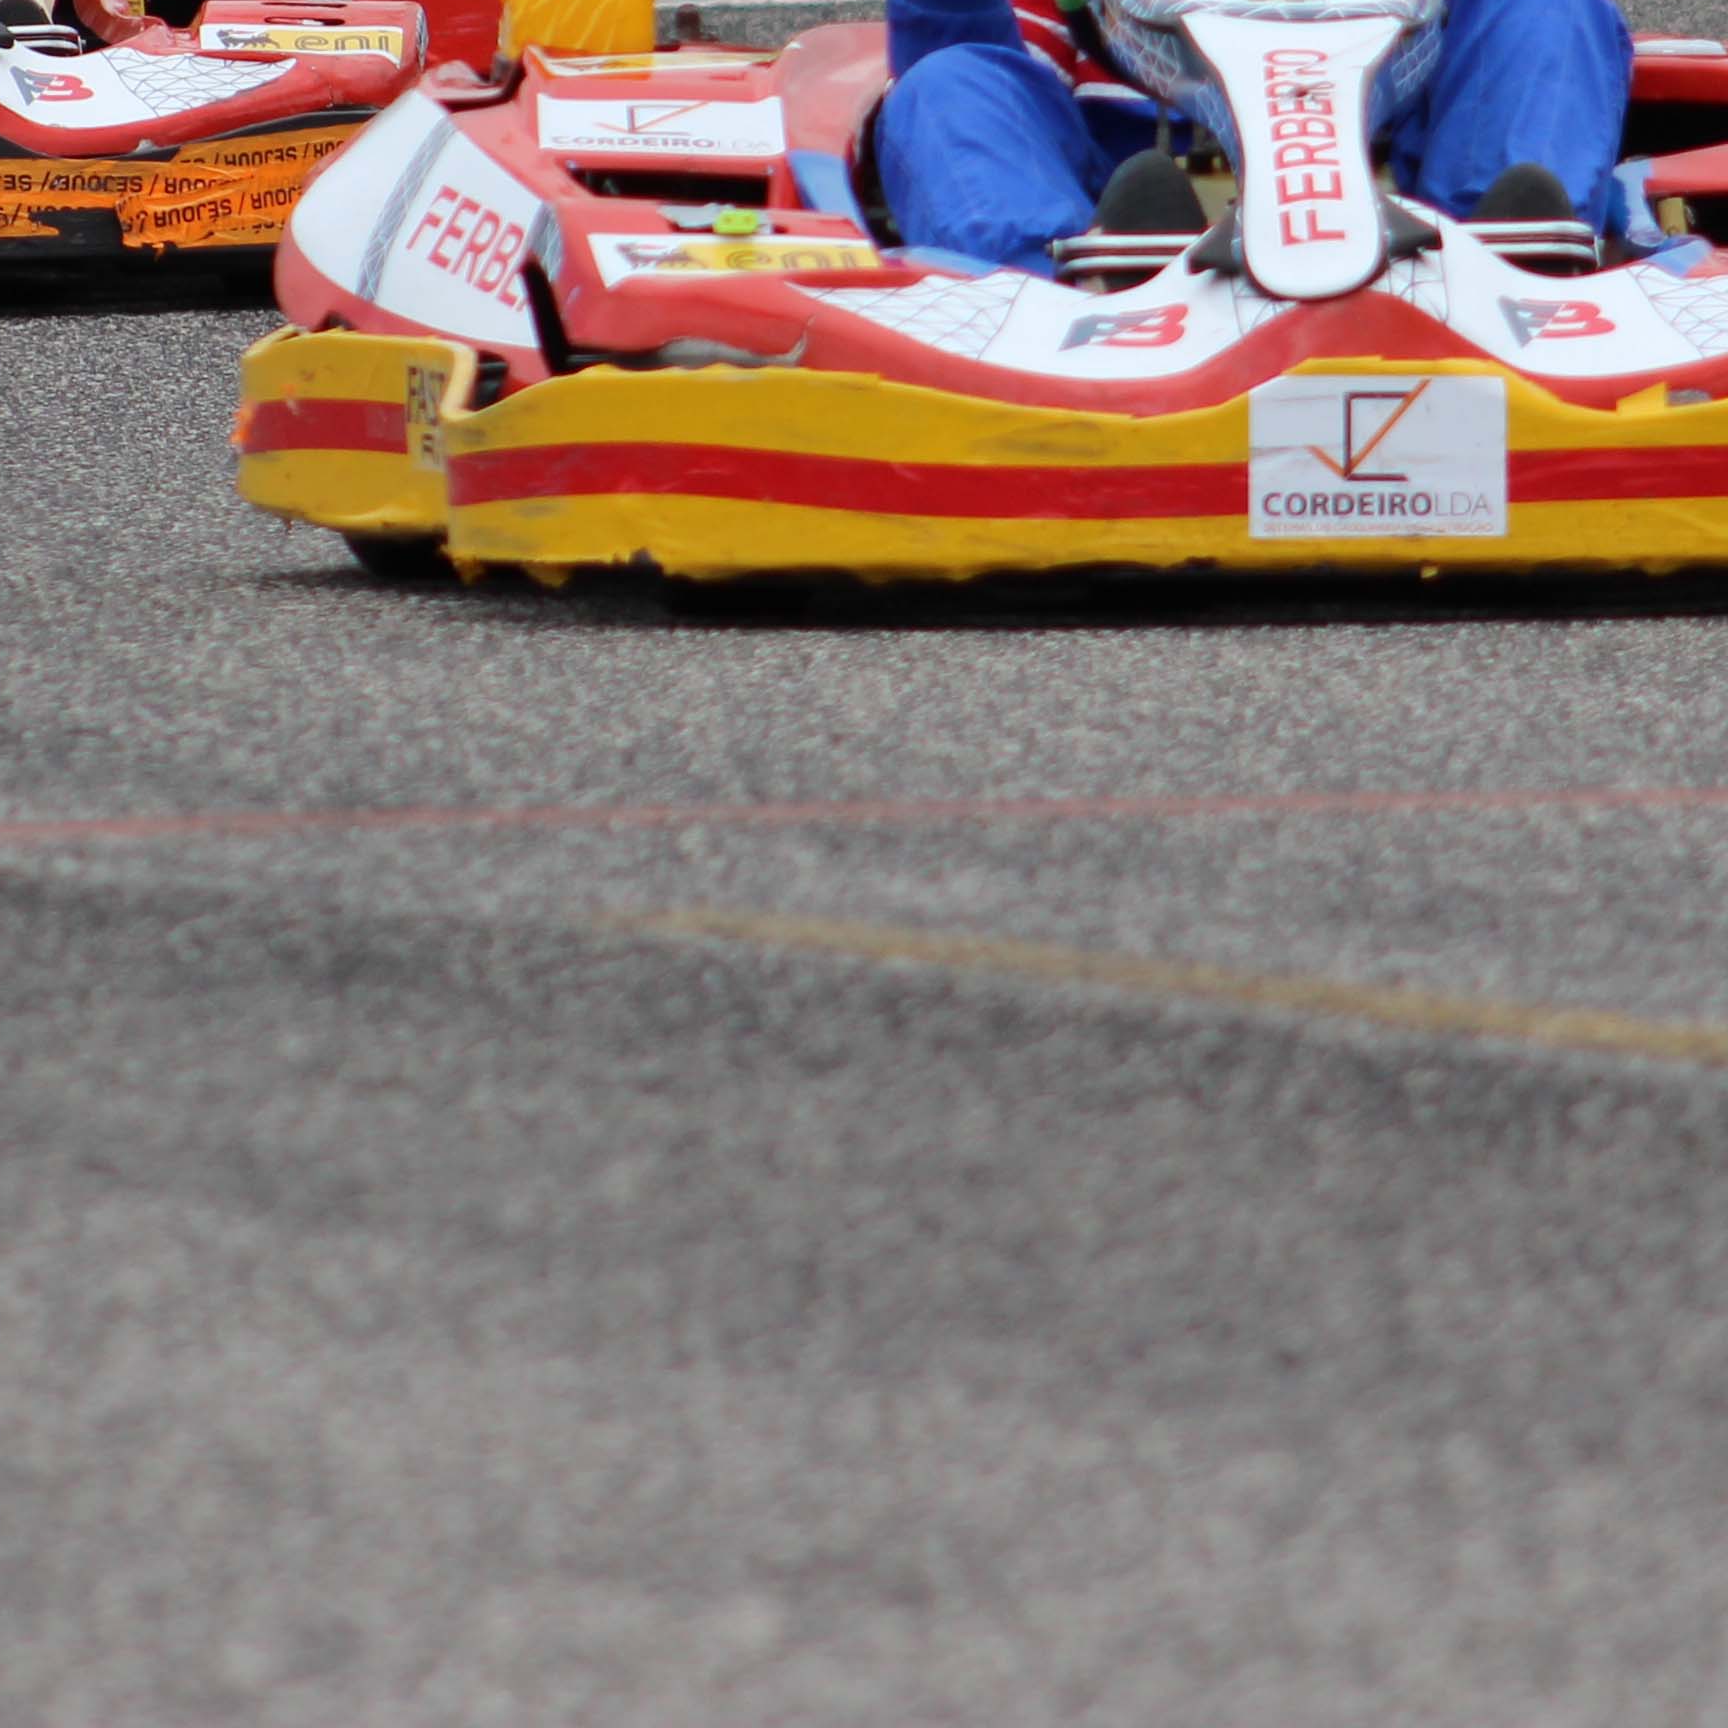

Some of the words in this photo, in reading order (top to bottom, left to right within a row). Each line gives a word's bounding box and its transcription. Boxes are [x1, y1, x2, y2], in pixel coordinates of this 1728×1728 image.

[294, 33, 390, 52] eni
[1264, 48, 1347, 246] FERBERTO
[154, 197, 233, 230] SÉJOUR
[723, 248, 867, 270] eni
